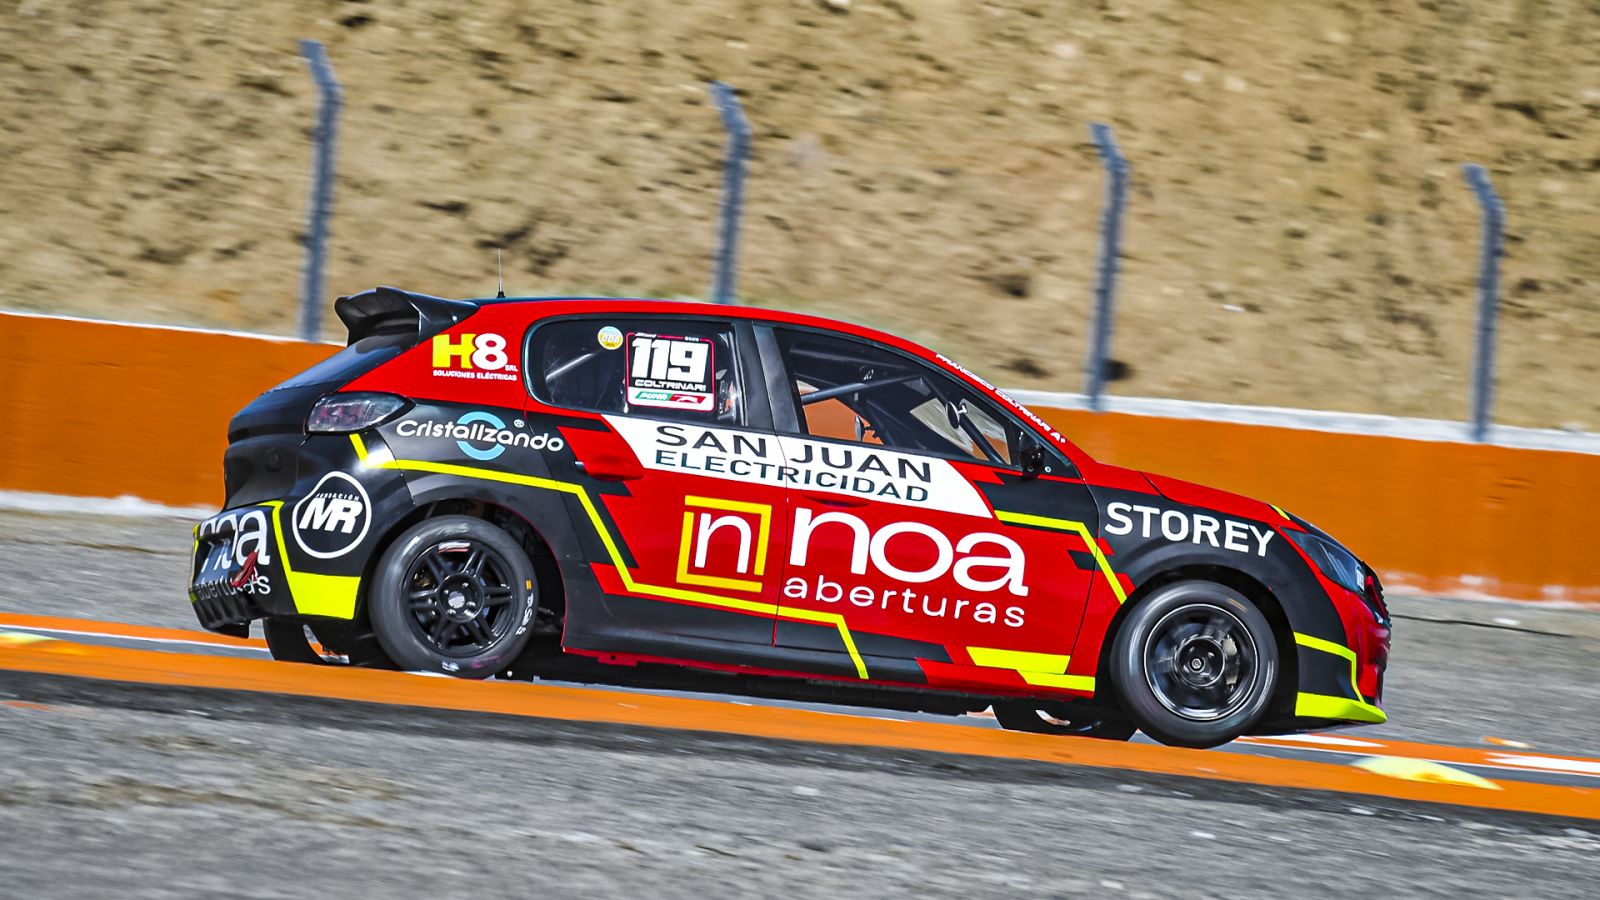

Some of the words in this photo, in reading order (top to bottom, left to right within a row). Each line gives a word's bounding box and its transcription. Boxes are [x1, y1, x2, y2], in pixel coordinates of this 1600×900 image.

[432, 333, 508, 370] H8
[432, 370, 476, 379] SOLUCIONES
[632, 337, 709, 383] 119
[634, 379, 706, 392] COLTRINARI
[655, 450, 929, 503] ELECTRICIDAD
[656, 425, 768, 458] SAN
[790, 444, 932, 483] JUAN
[298, 498, 363, 534] MR
[1104, 502, 1275, 557] STOREY
[789, 506, 1029, 597] noa
[783, 574, 1026, 628] aberturas
